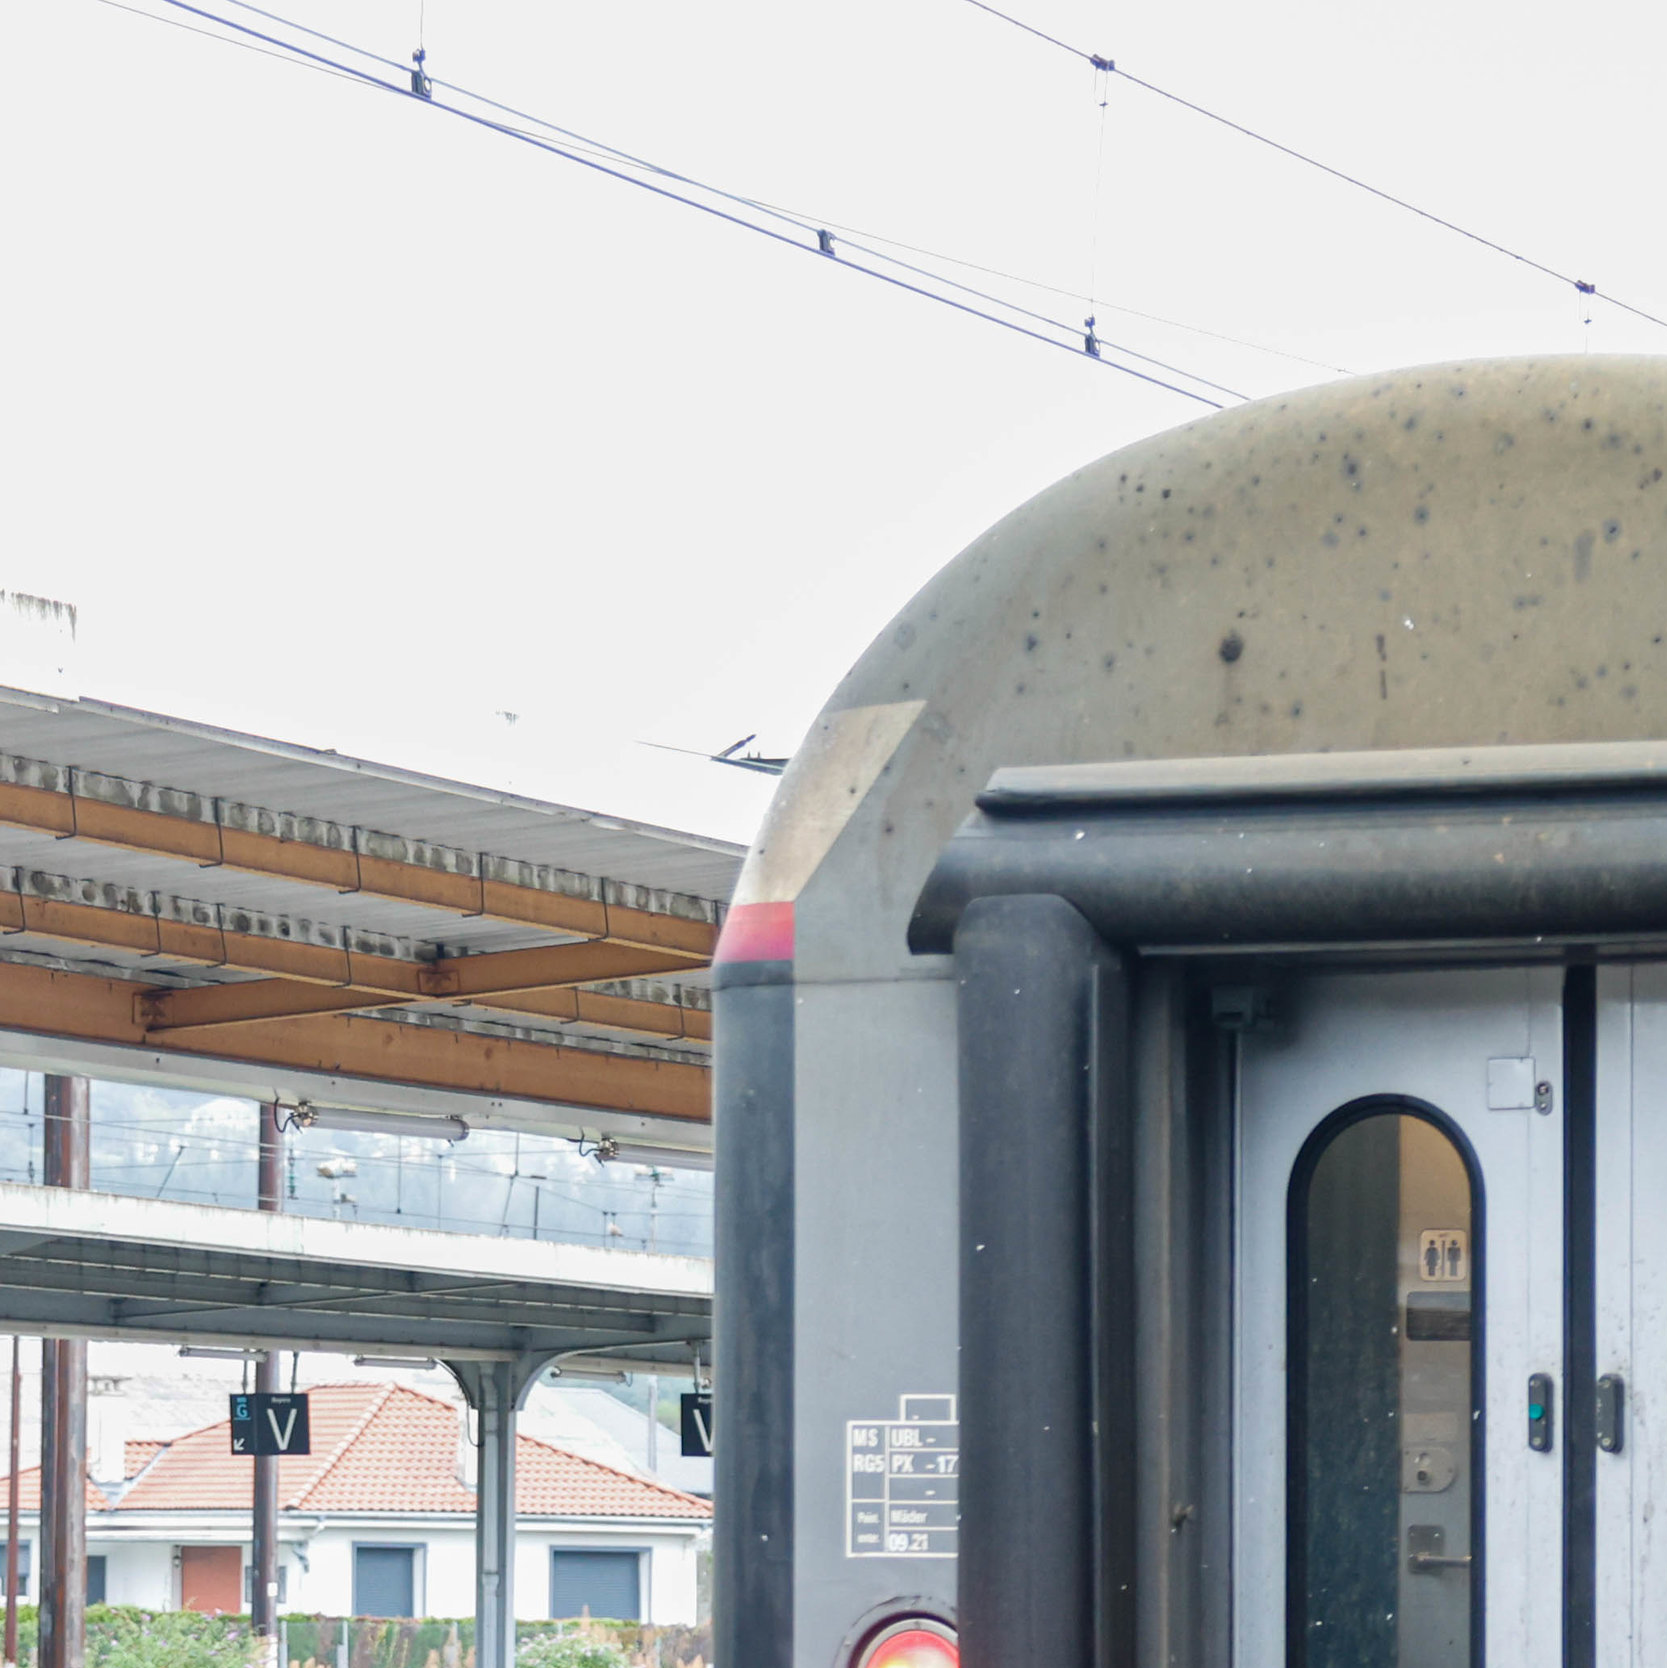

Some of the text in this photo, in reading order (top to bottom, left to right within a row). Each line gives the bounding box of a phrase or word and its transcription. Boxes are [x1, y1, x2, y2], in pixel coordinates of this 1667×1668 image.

[236, 1404, 248, 1417] G
[266, 1408, 297, 1450] V
[853, 1429, 878, 1446] MS
[891, 1429, 922, 1447] UBL
[853, 1455, 884, 1472] RG5
[892, 1455, 914, 1472] PX
[888, 1534, 928, 1551] 09.21
